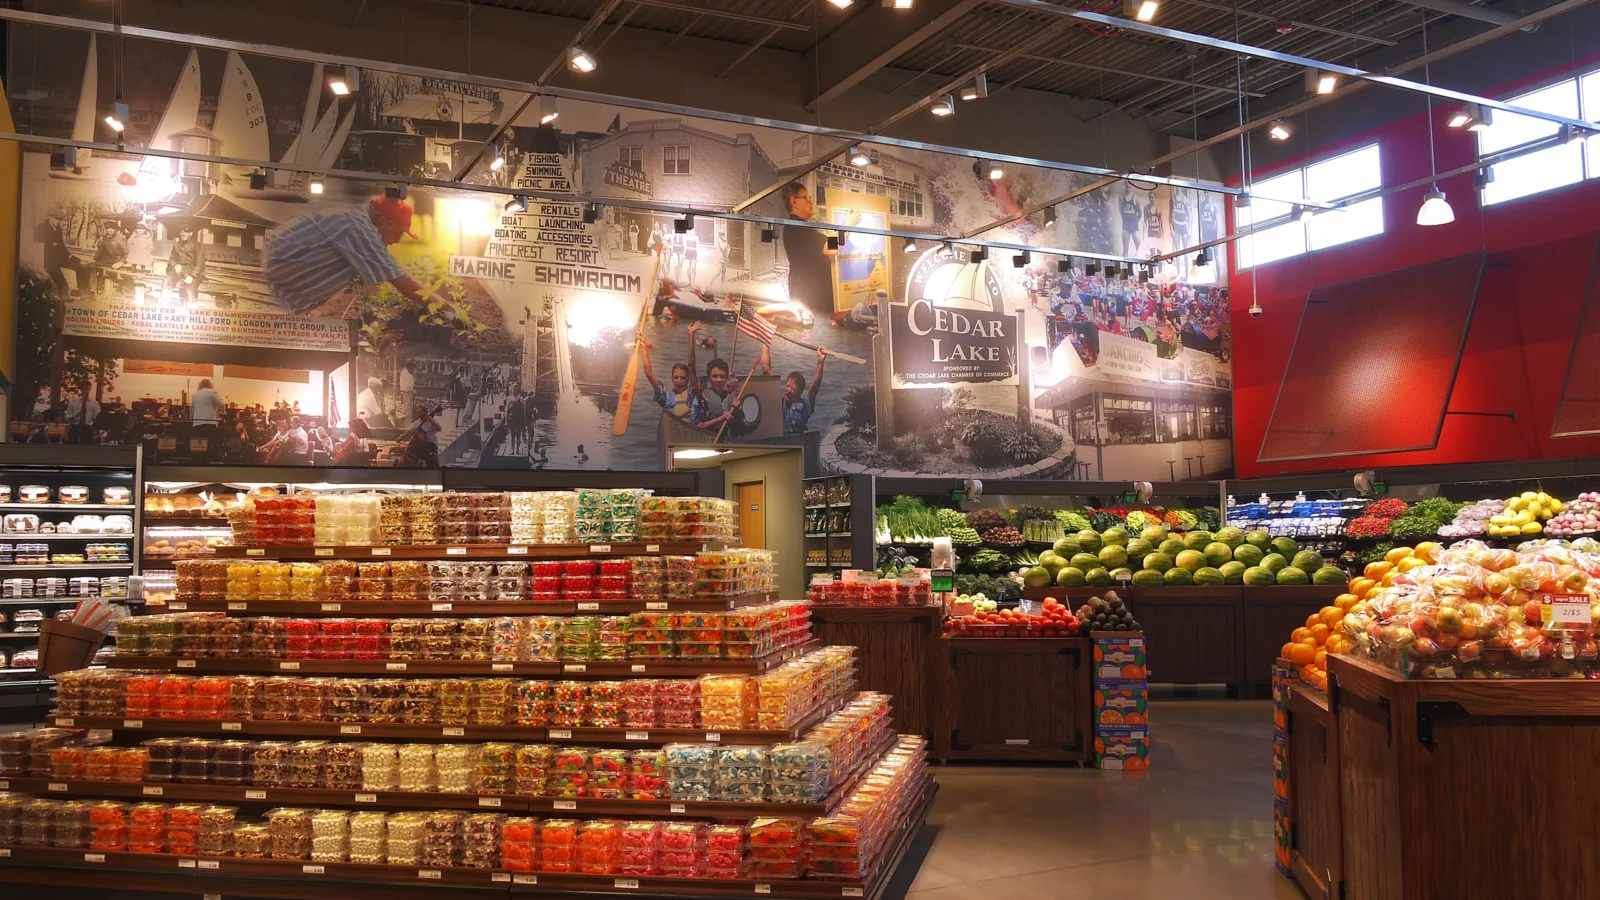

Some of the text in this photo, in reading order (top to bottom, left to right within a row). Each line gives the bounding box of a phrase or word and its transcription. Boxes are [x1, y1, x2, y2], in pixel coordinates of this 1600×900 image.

[426, 80, 465, 94] GENERAL
[466, 90, 489, 99] STORE
[246, 93, 252, 101] B
[249, 116, 264, 129] 303
[528, 154, 559, 164] FISHING
[526, 166, 562, 176] SWIMMING
[618, 166, 644, 180] CEDAR
[517, 178, 571, 190] PICNIC AREA
[609, 171, 650, 192] THEATRE
[540, 205, 580, 216] RENTALS
[501, 216, 586, 230] BOAT LAUNCHING
[494, 228, 593, 245] BOATING ACCESSORIES
[489, 242, 599, 264] PINECREST RESORT
[453, 258, 641, 293] MARINE SHOWROOM
[988, 276, 998, 296] TO
[72, 308, 95, 316] TOWN
[112, 311, 138, 320] CEDAR
[239, 319, 270, 328] LONDON
[274, 322, 298, 330] WITTE
[213, 311, 266, 320] SUMMERFEST
[908, 299, 1005, 338] CEDAR
[192, 324, 231, 333] LAKEFRONT
[931, 339, 1000, 362] LAKE
